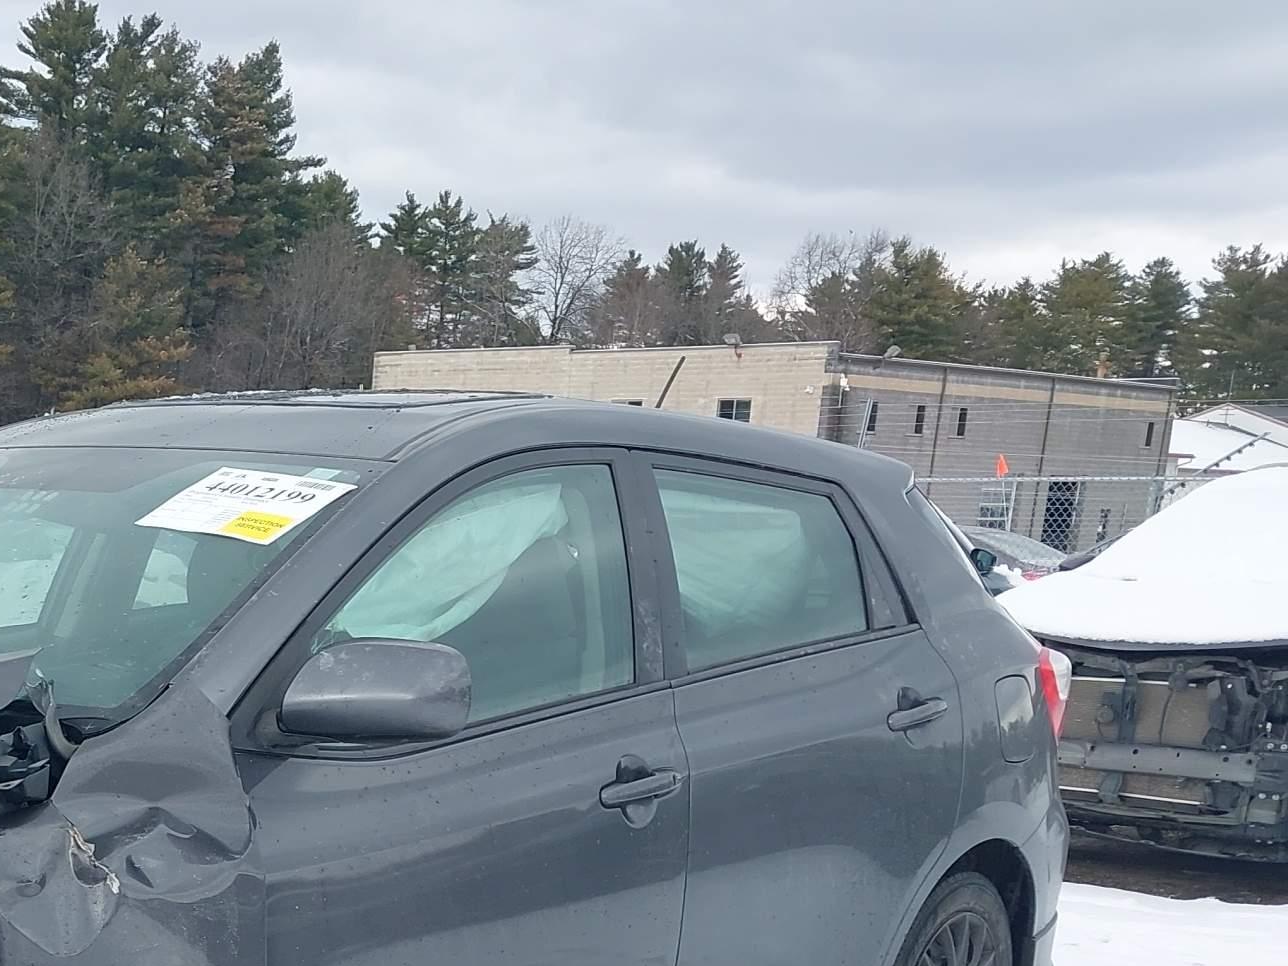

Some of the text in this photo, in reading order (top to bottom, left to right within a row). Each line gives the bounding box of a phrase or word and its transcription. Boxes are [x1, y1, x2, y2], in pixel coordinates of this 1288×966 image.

[205, 481, 316, 503] 44012199
[234, 522, 271, 533] SERVICE
[236, 516, 284, 528] INSPECTION
